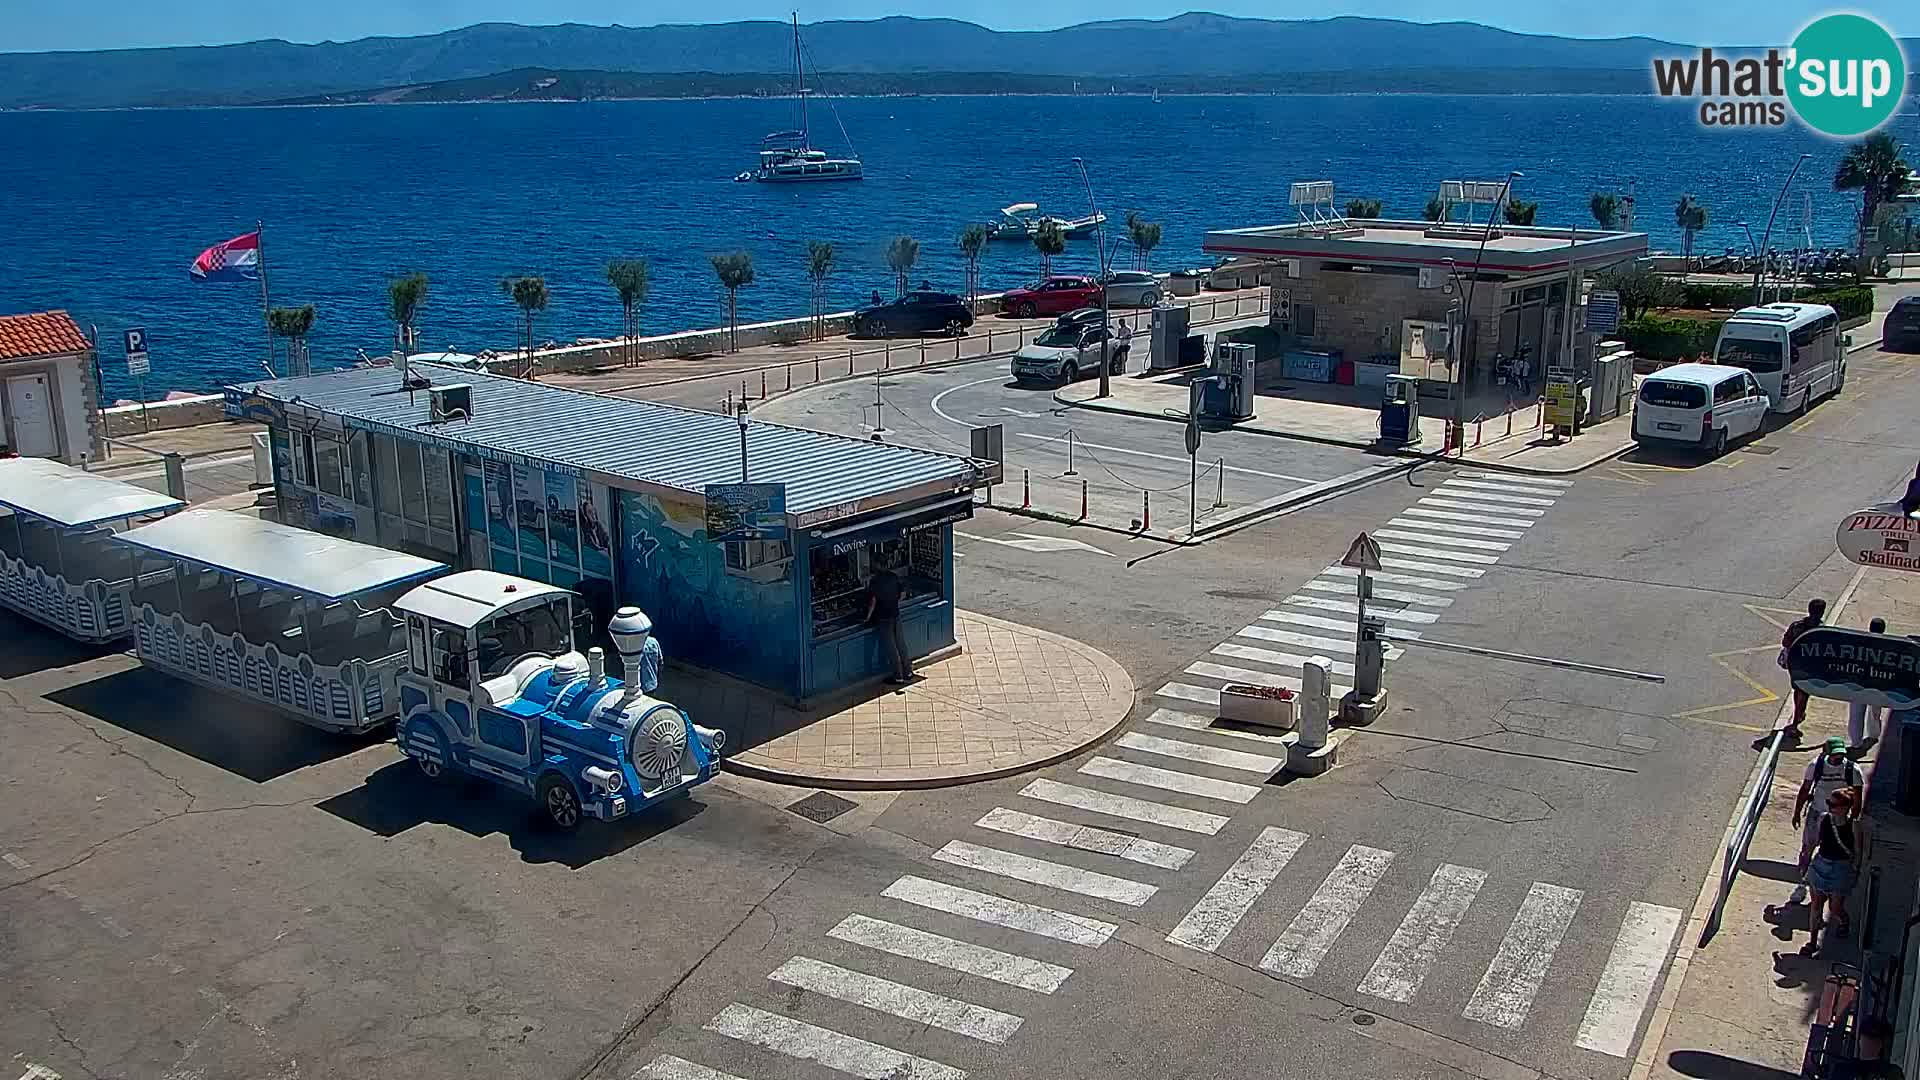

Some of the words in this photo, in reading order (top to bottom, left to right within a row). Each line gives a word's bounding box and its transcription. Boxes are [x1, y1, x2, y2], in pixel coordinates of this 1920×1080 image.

[129, 332, 142, 350] P
[395, 429, 434, 444] AUTOBUSNA
[477, 446, 492, 458] BUS
[492, 450, 525, 465] STATION
[527, 458, 553, 471] TICKET
[554, 463, 582, 477] OFFICE
[1880, 530, 1917, 541] GRILL
[833, 539, 867, 556] iNovine
[1827, 662, 1865, 674] caffe
[1870, 665, 1896, 680] bar
